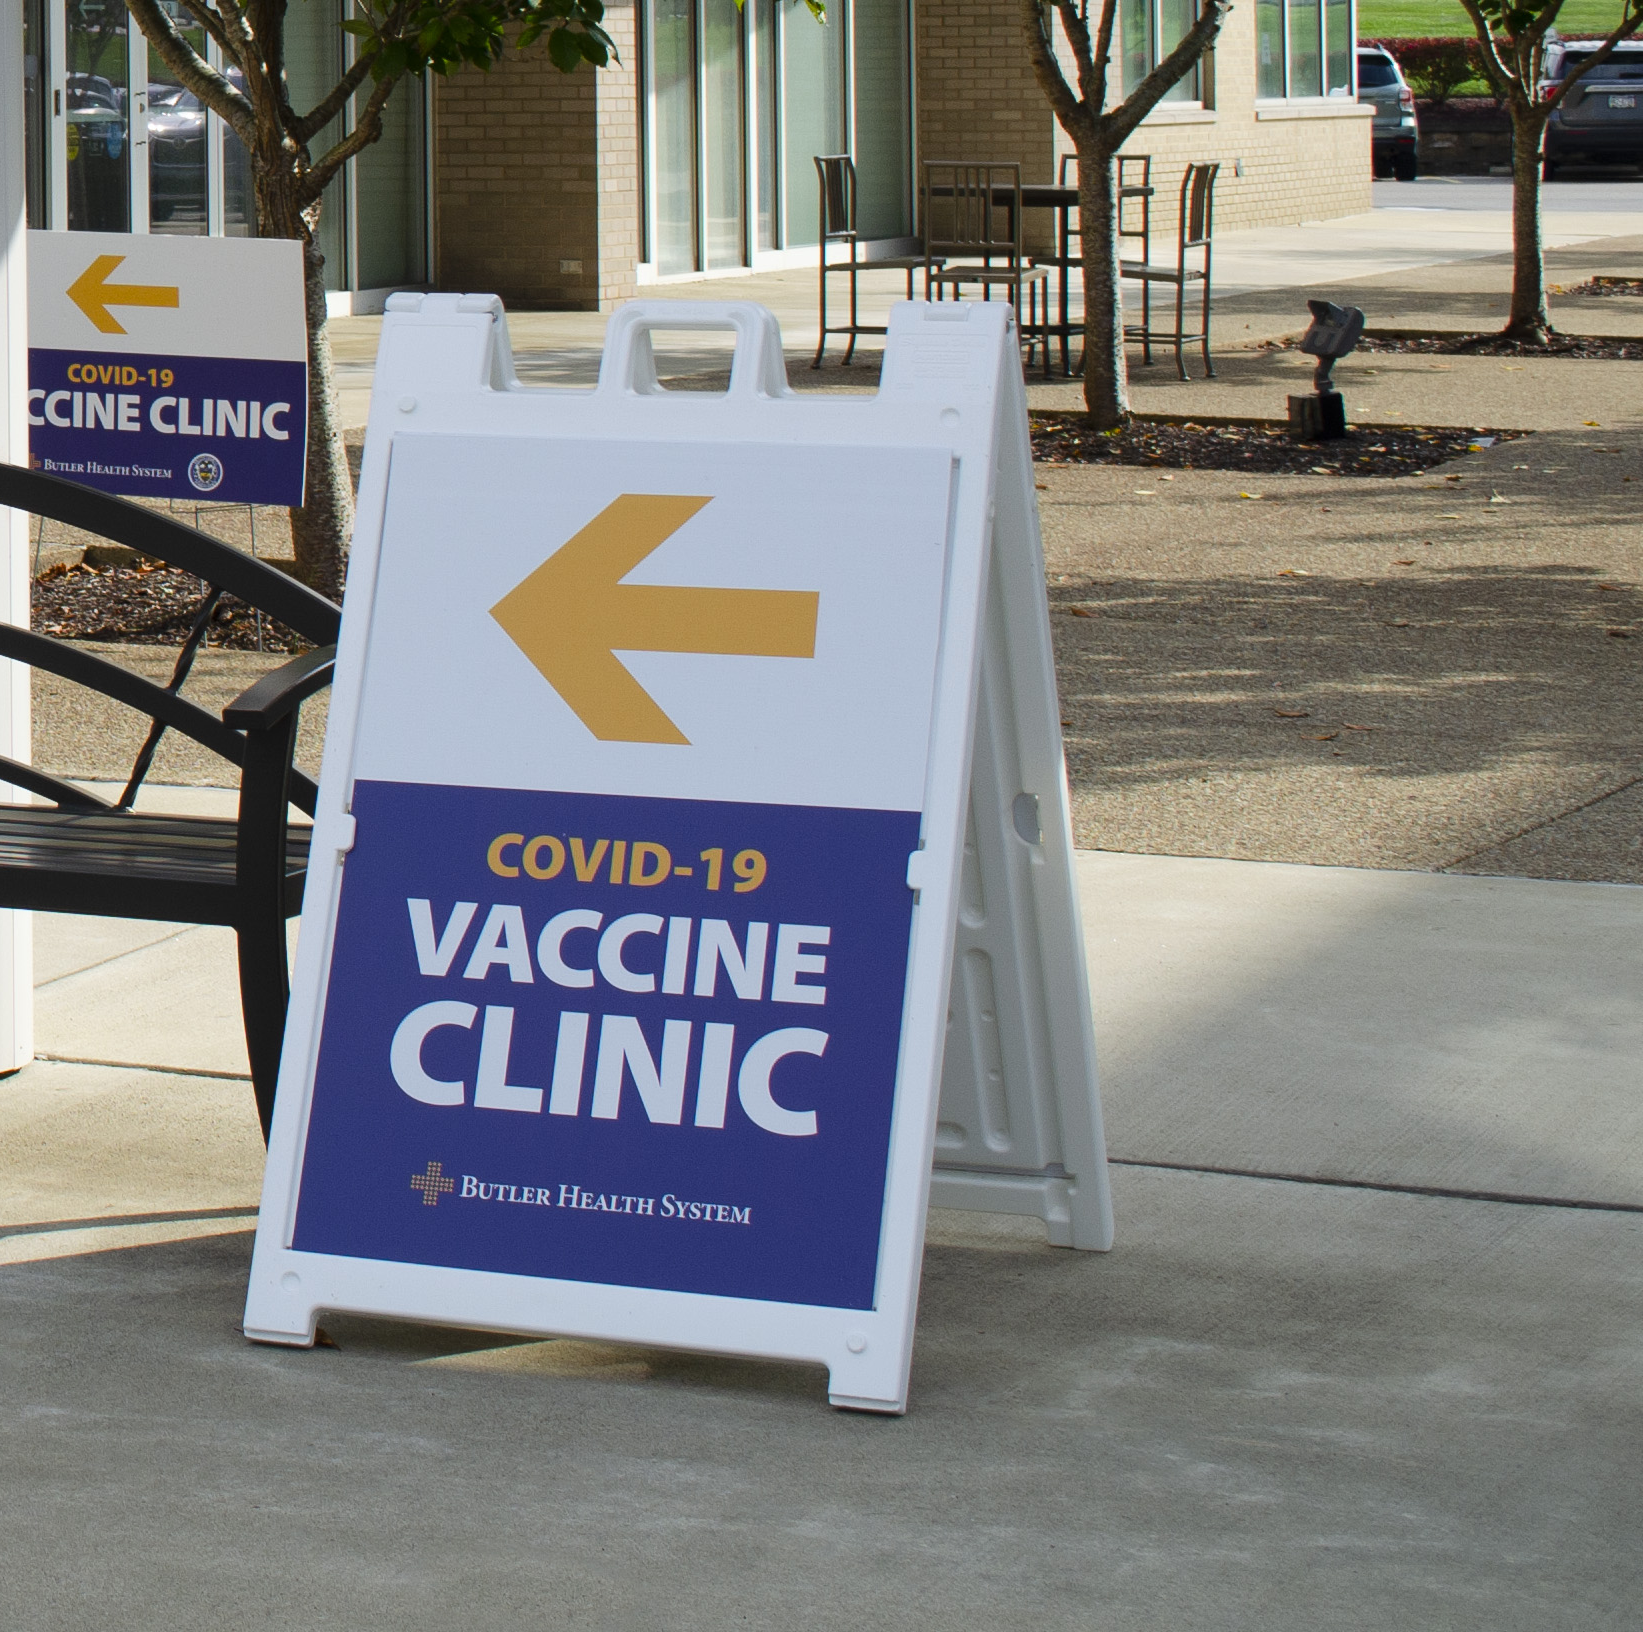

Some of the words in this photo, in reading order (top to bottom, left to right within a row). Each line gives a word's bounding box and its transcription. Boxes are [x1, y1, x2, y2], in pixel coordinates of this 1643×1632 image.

[67, 364, 175, 388] COVID-19
[28, 389, 142, 431] CCINE
[149, 396, 291, 441] CLINIC
[486, 832, 769, 893] COVID-19
[407, 897, 832, 1005] VACCINE
[390, 1000, 830, 1137] CLINIC
